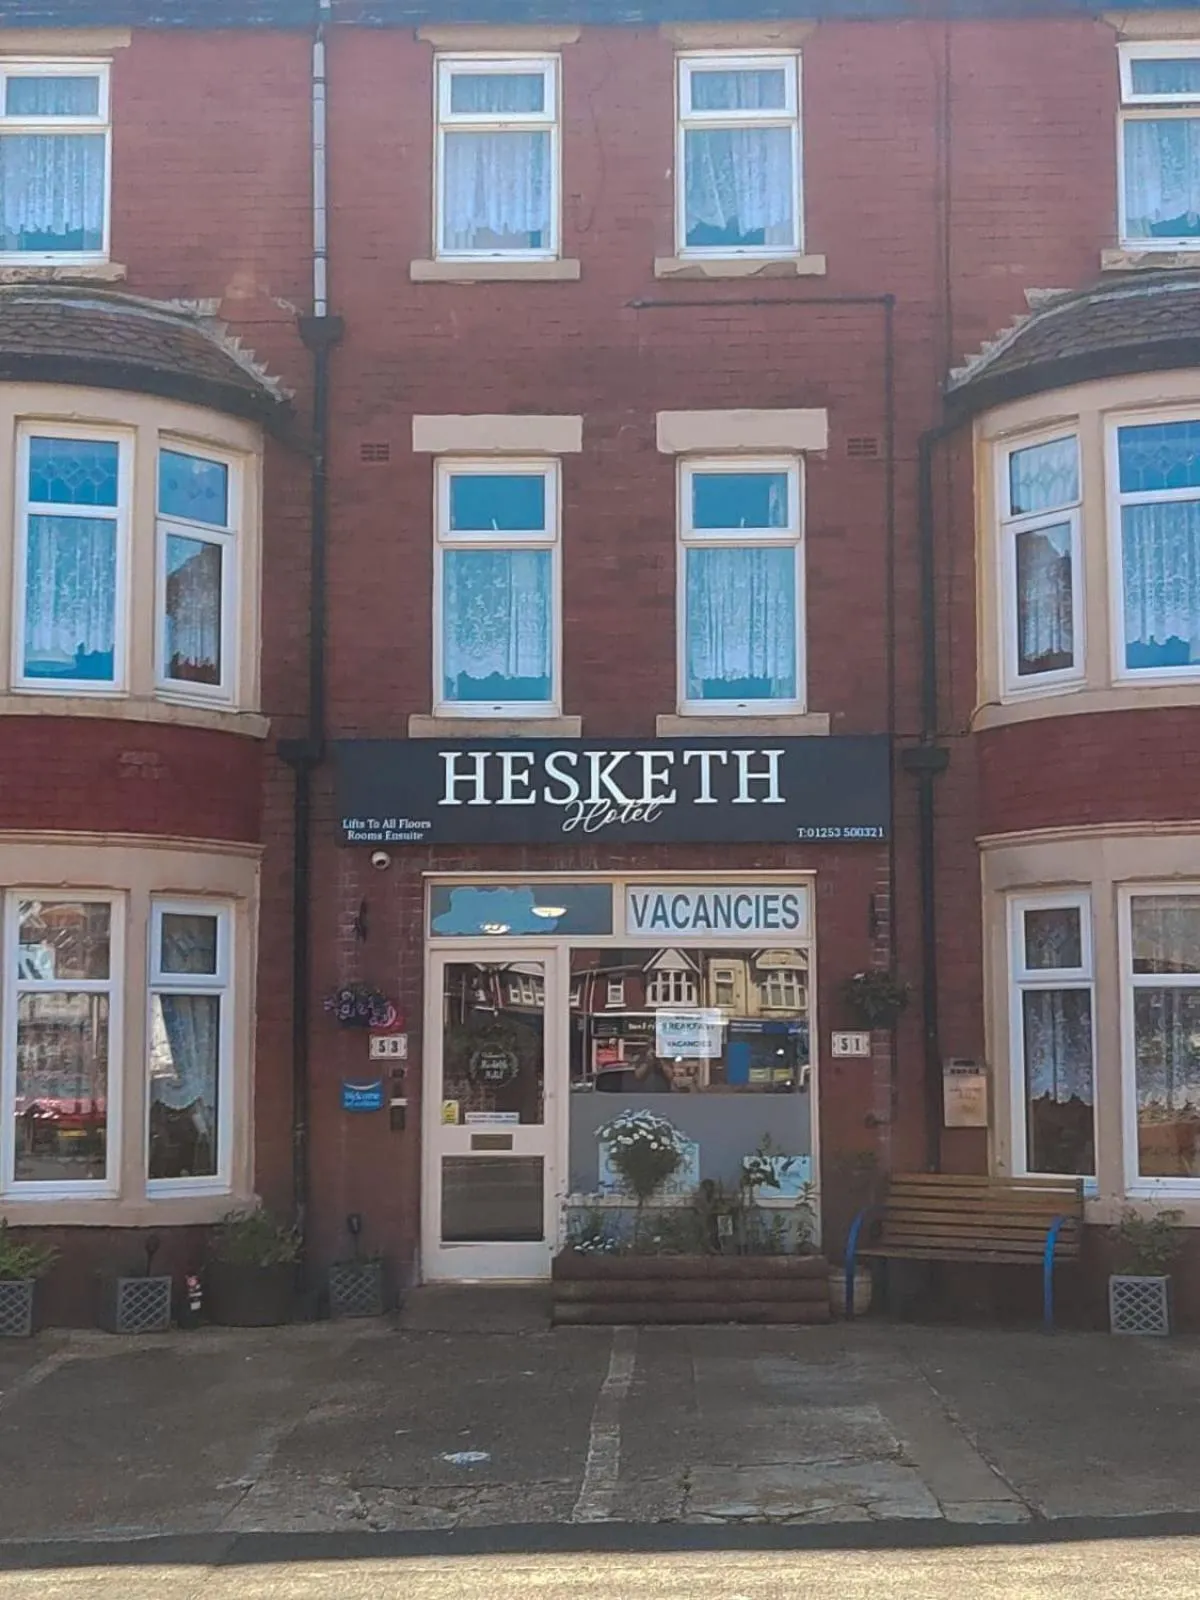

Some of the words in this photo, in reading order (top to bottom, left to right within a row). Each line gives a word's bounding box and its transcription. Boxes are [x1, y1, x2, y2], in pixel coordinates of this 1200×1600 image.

[437, 750, 786, 805] HESKETH
[342, 818, 365, 829] Lifts
[367, 819, 380, 829] To
[382, 818, 396, 829] All
[399, 818, 432, 829] Floors
[561, 796, 665, 834] Hotel
[347, 830, 382, 841] Rooms
[385, 830, 424, 841] Ensuite
[843, 827, 884, 838] 500321
[629, 893, 800, 930] VACANCIES
